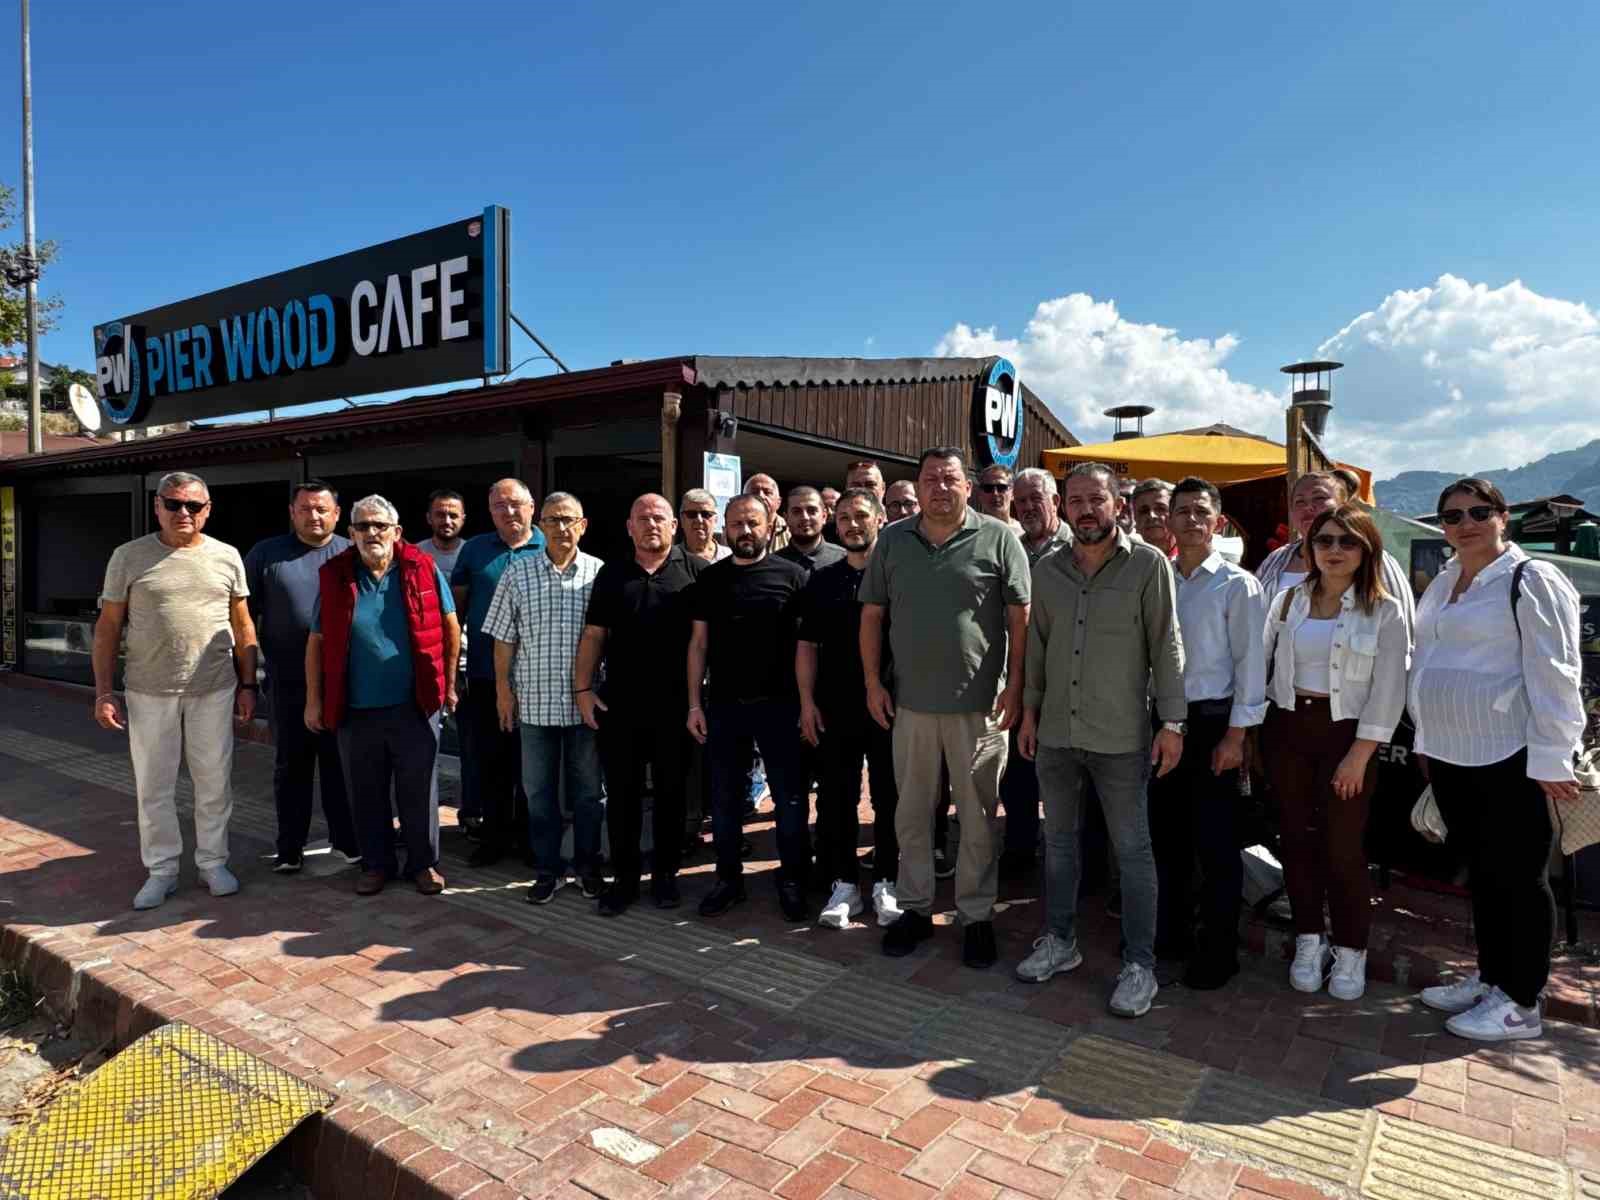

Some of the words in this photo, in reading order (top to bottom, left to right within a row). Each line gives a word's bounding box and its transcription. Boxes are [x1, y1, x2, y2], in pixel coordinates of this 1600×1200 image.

[96, 324, 131, 397] PW
[146, 324, 214, 396] PIER
[219, 294, 336, 382] WOOD
[351, 255, 469, 356] CAFE
[985, 370, 1020, 439] PW
